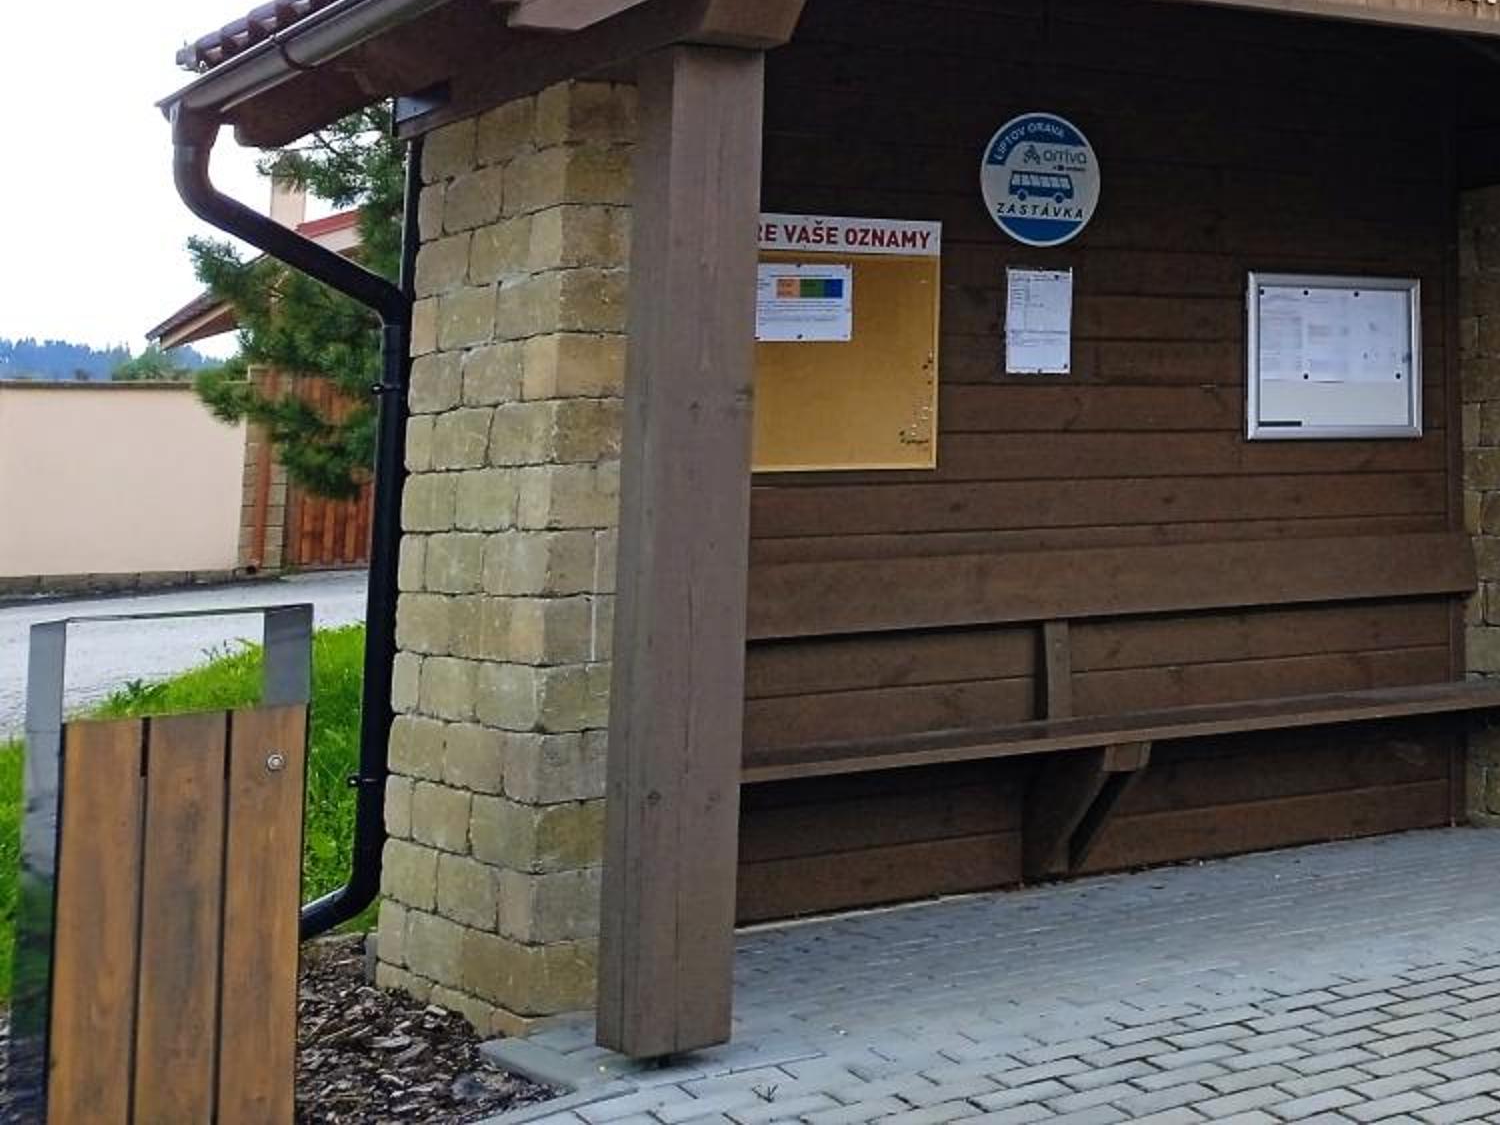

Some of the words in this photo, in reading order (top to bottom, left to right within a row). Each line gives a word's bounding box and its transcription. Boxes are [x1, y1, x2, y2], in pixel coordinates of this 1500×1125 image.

[993, 126, 1025, 160] LIPTOV
[997, 200, 1084, 219] ZASTÁVKA
[783, 220, 839, 245] VAŠE
[845, 227, 931, 250] OZNAMY
